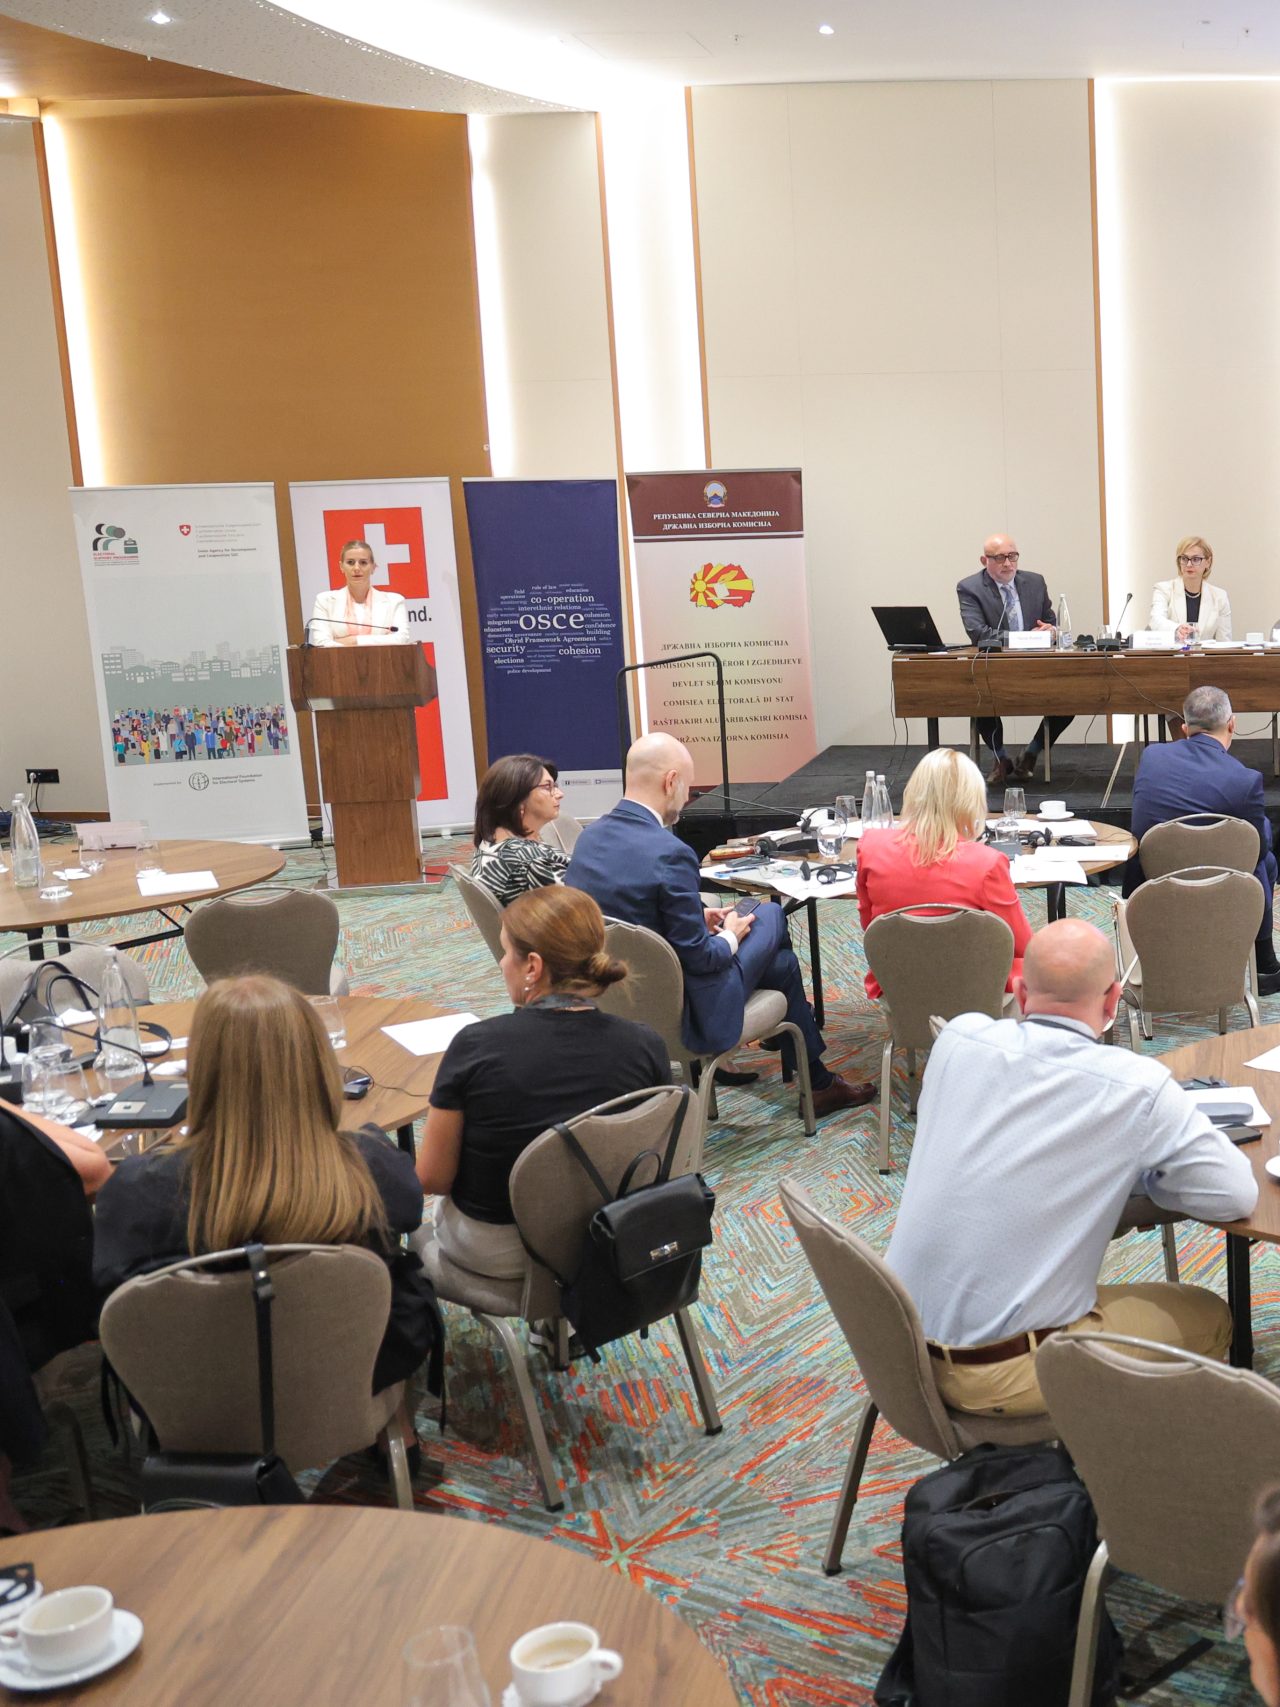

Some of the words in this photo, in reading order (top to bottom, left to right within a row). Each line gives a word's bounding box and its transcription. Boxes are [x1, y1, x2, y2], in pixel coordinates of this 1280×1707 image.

[653, 512, 697, 521] РЕПУБЛИКА
[698, 511, 731, 520] СЕВЕРНА
[731, 510, 780, 519] МАКЕДОНИЈА
[662, 522, 698, 531] ДРЖАВНА
[699, 521, 731, 529] ИЗБОРНА
[732, 520, 772, 528] КОМИСИЈА
[530, 594, 595, 605] co-operation
[554, 603, 582, 611] relations
[486, 643, 526, 654] security
[558, 645, 601, 656] cohesion
[661, 643, 702, 651] ДРЖАВНА
[704, 641, 742, 649] ИЗБОРНА
[743, 639, 789, 648] КОМИСИЈА
[494, 657, 525, 665] elections
[672, 680, 703, 688] DEVLET
[734, 677, 784, 686] KOMISYONU
[775, 695, 795, 703] STAT
[703, 714, 772, 724] ALUARIBASKIRI
[772, 713, 808, 722] KOMISIA
[713, 734, 749, 742] IZORNA
[749, 733, 789, 741] KOMISIJA
